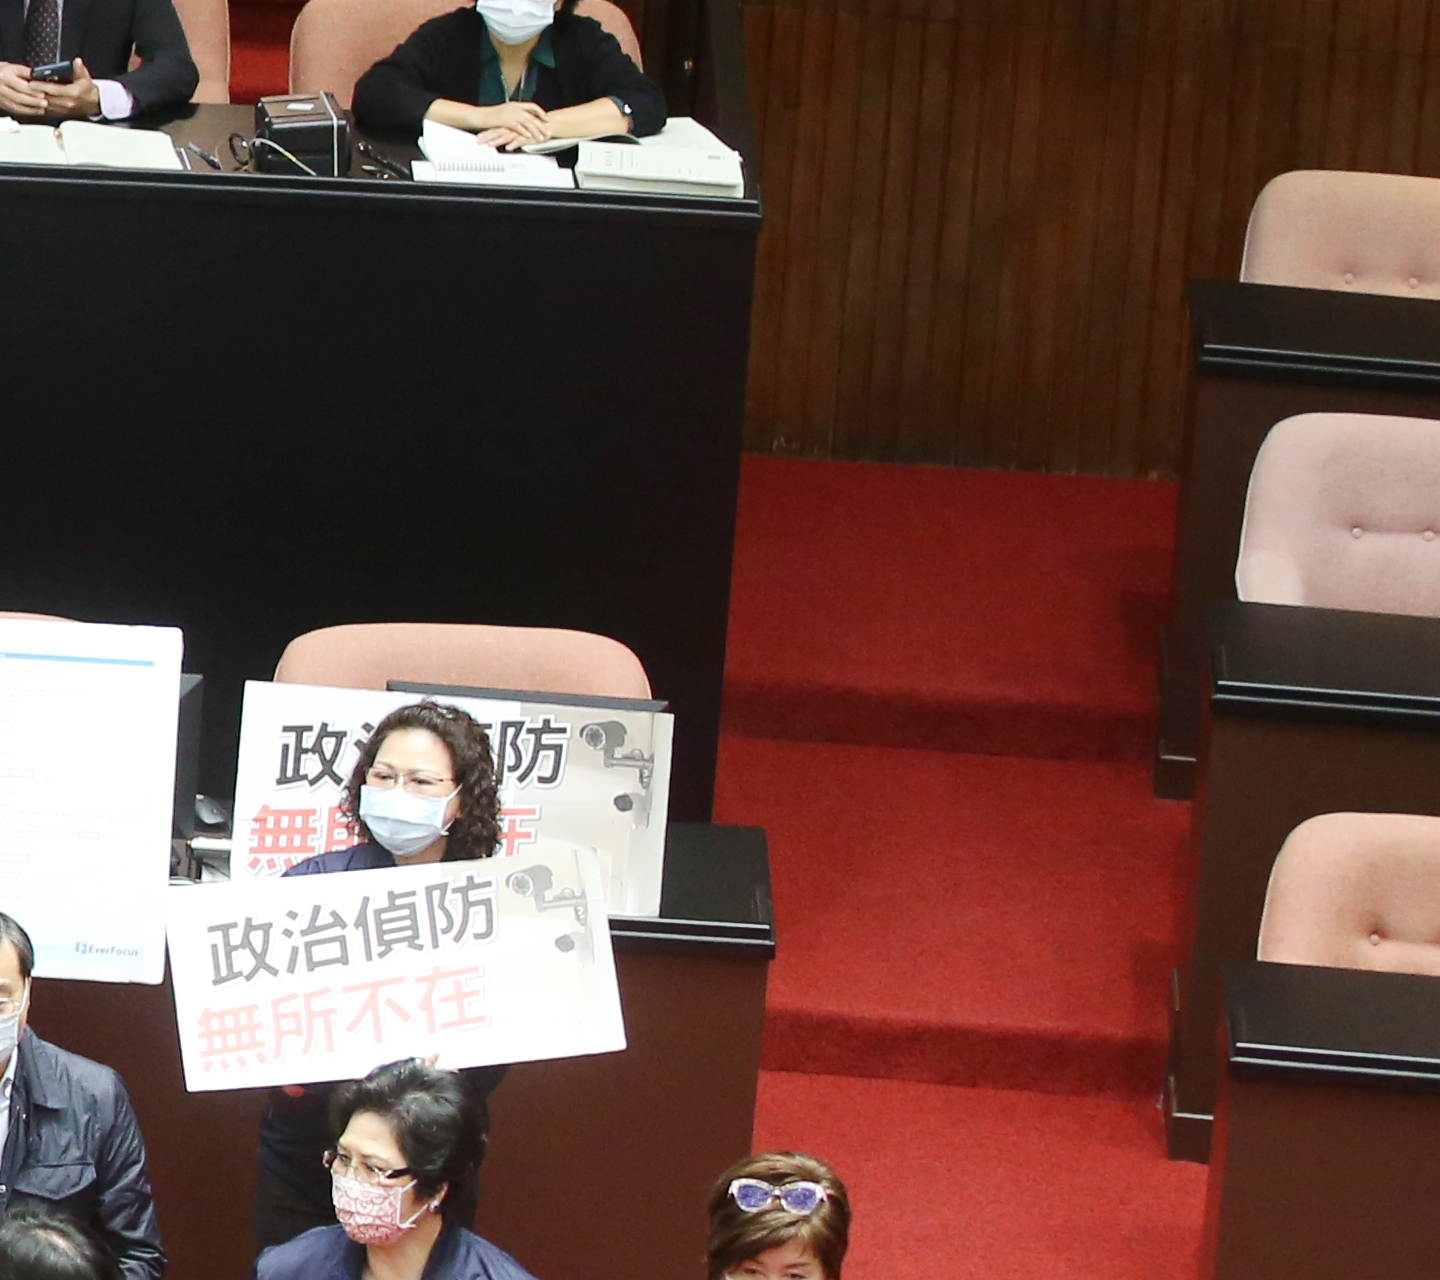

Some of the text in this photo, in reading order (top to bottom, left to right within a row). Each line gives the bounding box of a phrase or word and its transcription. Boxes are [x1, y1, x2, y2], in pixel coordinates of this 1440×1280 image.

[277, 717, 568, 788] 政防
[88, 944, 139, 957] EverFocus
[208, 873, 497, 987] 政治偵防
[197, 967, 488, 1074] 無所不在
